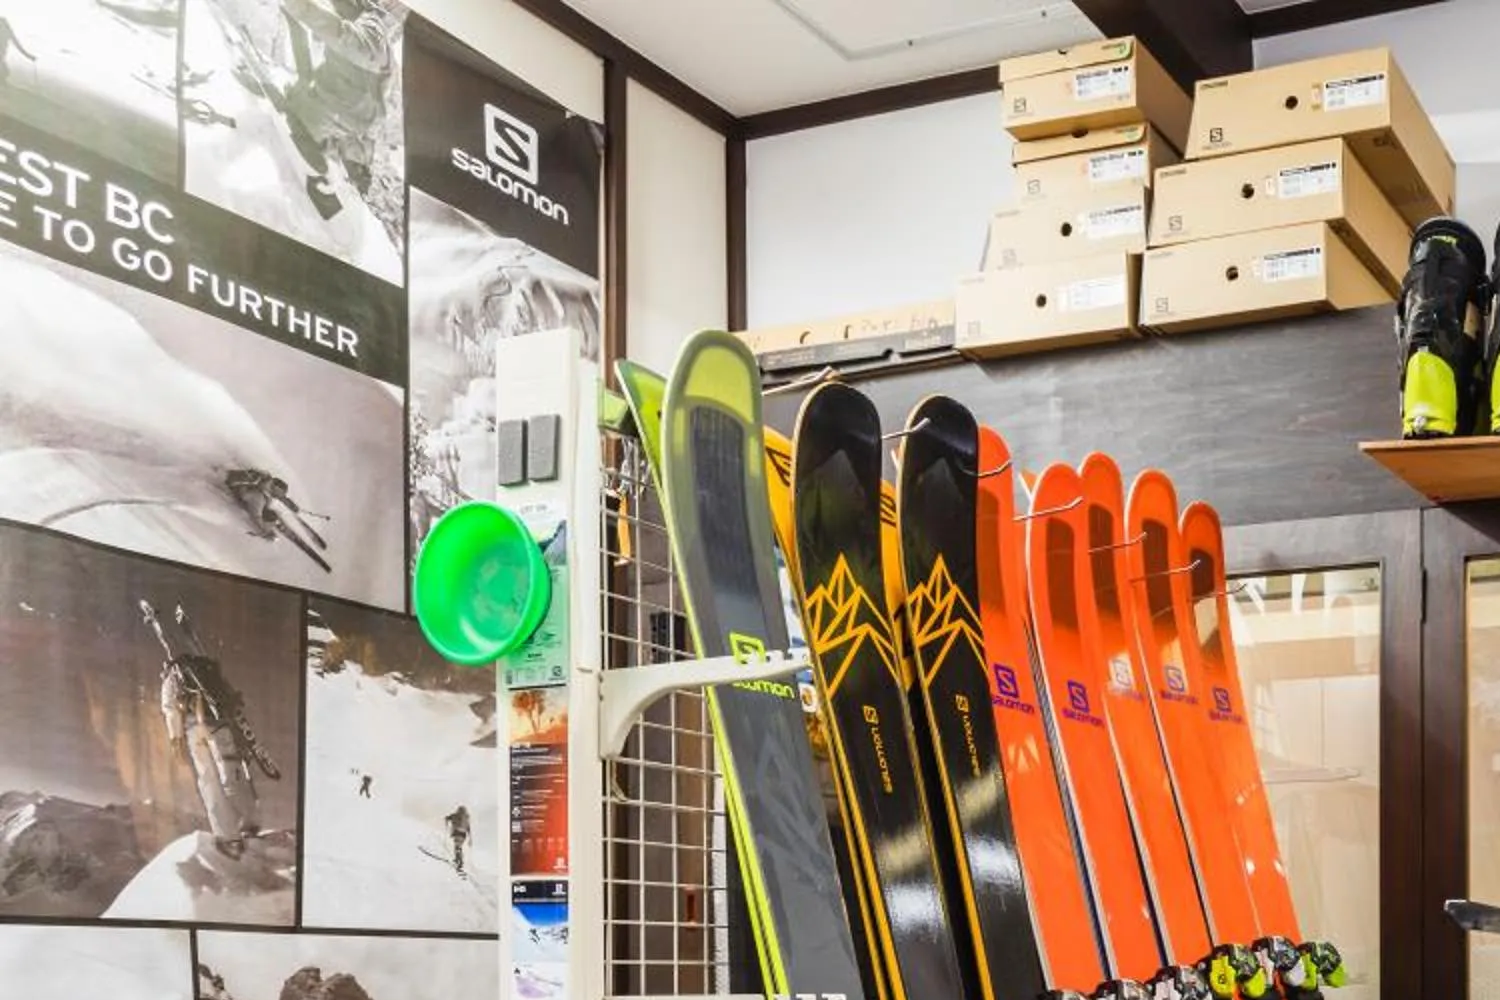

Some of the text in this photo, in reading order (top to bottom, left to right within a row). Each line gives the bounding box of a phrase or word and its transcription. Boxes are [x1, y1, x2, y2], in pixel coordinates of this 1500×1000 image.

[106, 183, 174, 244] BC
[451, 147, 569, 225] salomon
[33, 206, 95, 252] TO
[112, 237, 173, 282] GO
[187, 263, 359, 357] FURTHER
